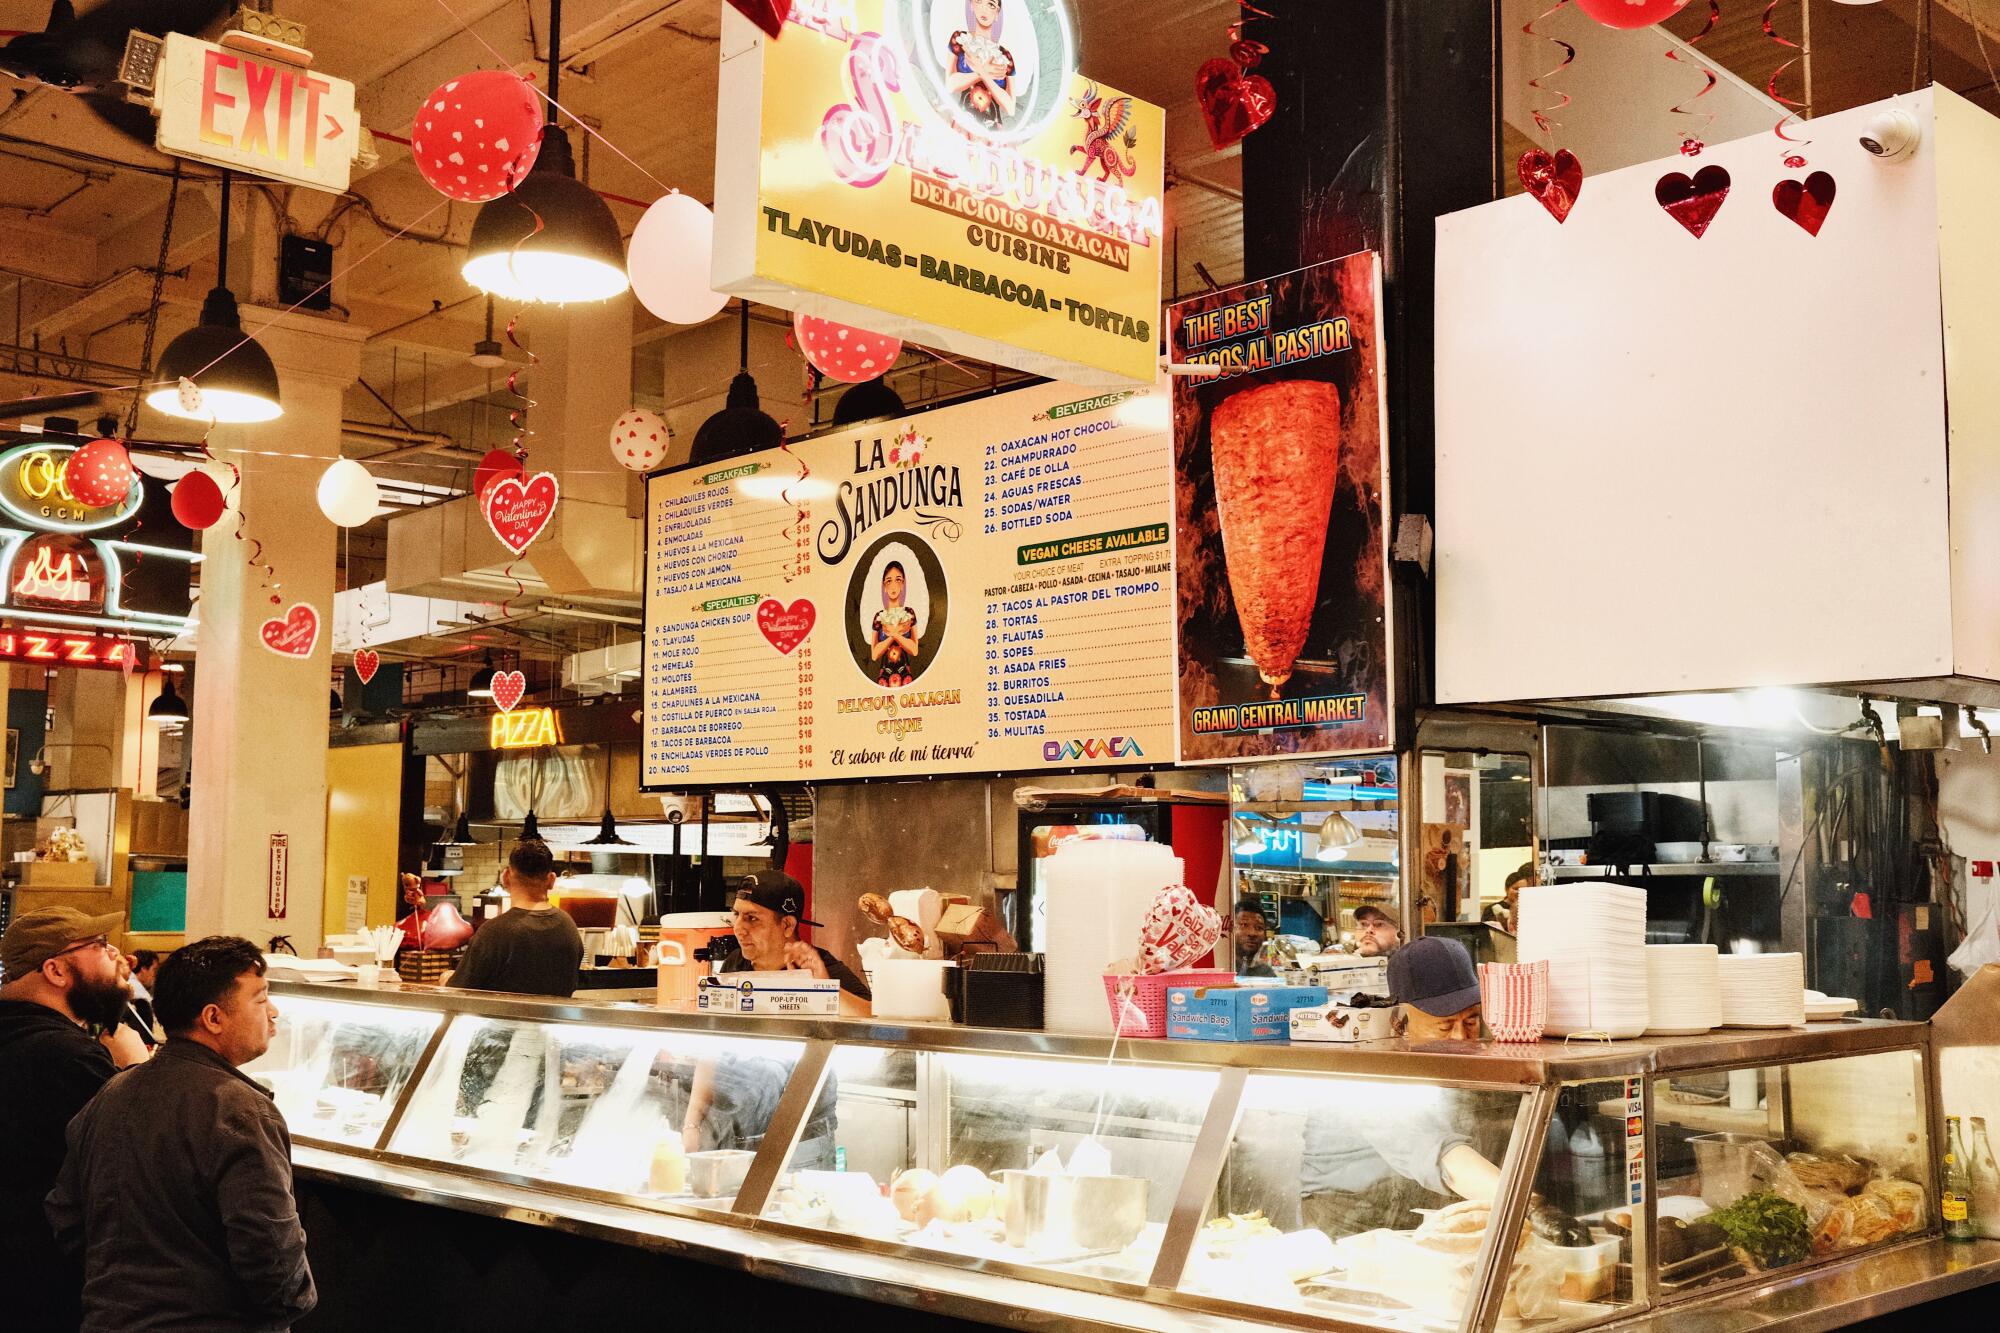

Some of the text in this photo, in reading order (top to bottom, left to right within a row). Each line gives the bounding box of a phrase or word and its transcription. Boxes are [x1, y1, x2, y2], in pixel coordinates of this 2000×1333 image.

[200, 49, 330, 168] EXIT
[912, 179, 1129, 266] DELICIOUS OAXACAN
[967, 224, 1071, 274] CUISINE
[1064, 298, 1150, 343] TORTAS
[1185, 295, 1271, 348] THE BEST
[1186, 318, 1350, 386] TACOS AL PASTOR
[1055, 392, 1125, 418] BEVERAGES
[1001, 435, 1048, 452] OAXACAN
[1051, 429, 1070, 441] HOT
[854, 439, 886, 474] LA
[1001, 444, 1077, 467] CHAMPURRADO
[708, 465, 754, 484] BREAKFAST
[1001, 461, 1070, 483] CAFÉ DE OLLA
[665, 486, 729, 508] CHILAQUILES ROJOS
[1001, 476, 1082, 500] AGUAS FRESCAS
[665, 499, 733, 520] CHILAQUILES VERDES
[1001, 494, 1070, 515] SODAS/WATER
[515, 520, 529, 529] DAY
[664, 516, 712, 532] ENFRIJOLADAS
[817, 465, 963, 565] SANDUNGA
[1001, 510, 1073, 531] BOTTLED SODA
[664, 531, 704, 545] ENMOLADAS
[664, 546, 690, 557] HUEVOS
[692, 544, 697, 552] A
[698, 541, 706, 551] LA
[708, 536, 744, 549] MEXICANA
[1023, 528, 1166, 562] VEGAN CHEESE AVAILABLE
[664, 558, 689, 570] HUEVOS
[692, 555, 705, 565] CON
[708, 550, 737, 563] CHORIZO
[1100, 558, 1121, 568] EXTRA
[1125, 553, 1154, 565] TOPPING
[664, 571, 689, 583] HUEVOS
[691, 568, 705, 578] CON
[708, 564, 731, 576] JAMON
[1013, 563, 1084, 581] YOUR CHOICE OF MEAT
[664, 583, 687, 595] TASAJO
[695, 580, 704, 590] LA
[706, 575, 741, 588] MEXICANA
[985, 584, 1006, 597] PASTOR
[1010, 583, 1034, 594] CABEZA
[1038, 579, 1057, 589] POLLO
[1062, 577, 1083, 586] ASADA
[1088, 573, 1111, 583] CECINA
[1116, 568, 1140, 578] TASAJO
[706, 595, 756, 611] SPECIALTIES
[1002, 582, 1159, 612] TACOS AL PASTOR DEL TROMPO
[663, 614, 751, 633] SANDUNGA CHICKEN SOUP
[1003, 615, 1038, 627] TORTAS
[663, 635, 695, 646] TLAYUDAS
[1002, 630, 1044, 643] FLAUTAS
[662, 647, 699, 658] MOLE ROJO
[1003, 647, 1033, 658] SOPES
[662, 661, 693, 671] MEMELAS
[1004, 659, 1066, 673] ASADA FRIES
[662, 674, 692, 683] MOLOTES
[1004, 677, 1050, 690] BURRITOS
[662, 686, 697, 696] ALAMBRES
[1004, 692, 1064, 706] QUESADILLA
[662, 697, 704, 709] CHAPULINES
[712, 696, 720, 705] LA
[723, 693, 760, 704] MEXICANA
[837, 689, 961, 717] DELICIOUS OAXACAN
[662, 711, 692, 721] COSTILLA
[695, 710, 704, 719] DE
[705, 707, 733, 717] PUERCO
[744, 707, 760, 715] SALSA
[1005, 709, 1046, 721] TOSTADA
[1193, 695, 1366, 732] GRAND CENTRAL MARKET
[491, 707, 557, 749] PIZZA
[662, 724, 696, 735] BARBACOA
[699, 724, 707, 732] DE
[709, 722, 742, 731] BORREGO
[876, 717, 922, 741] CUISINE
[1004, 725, 1045, 736] MULITAS
[662, 737, 683, 747] TACOS
[685, 737, 693, 746] DE
[695, 736, 731, 745] BARBACOA
[1043, 737, 1144, 761] OAXACA
[662, 748, 703, 760] ENCHILADAS
[705, 747, 732, 758] VERDES
[735, 747, 743, 756] DE
[745, 746, 769, 755] POLLO
[849, 749, 886, 765] sabor
[889, 746, 906, 762] de
[911, 745, 928, 761] mi
[662, 765, 689, 774] NACHOS
[272, 839, 286, 847] FIRE
[1179, 905, 1204, 936] Feliz
[1185, 934, 1204, 950] San
[1172, 1013, 1230, 1026] Sandwich Bags
[1297, 1012, 1321, 1020] NITRILE
[1628, 1102, 1641, 1113] VISA
